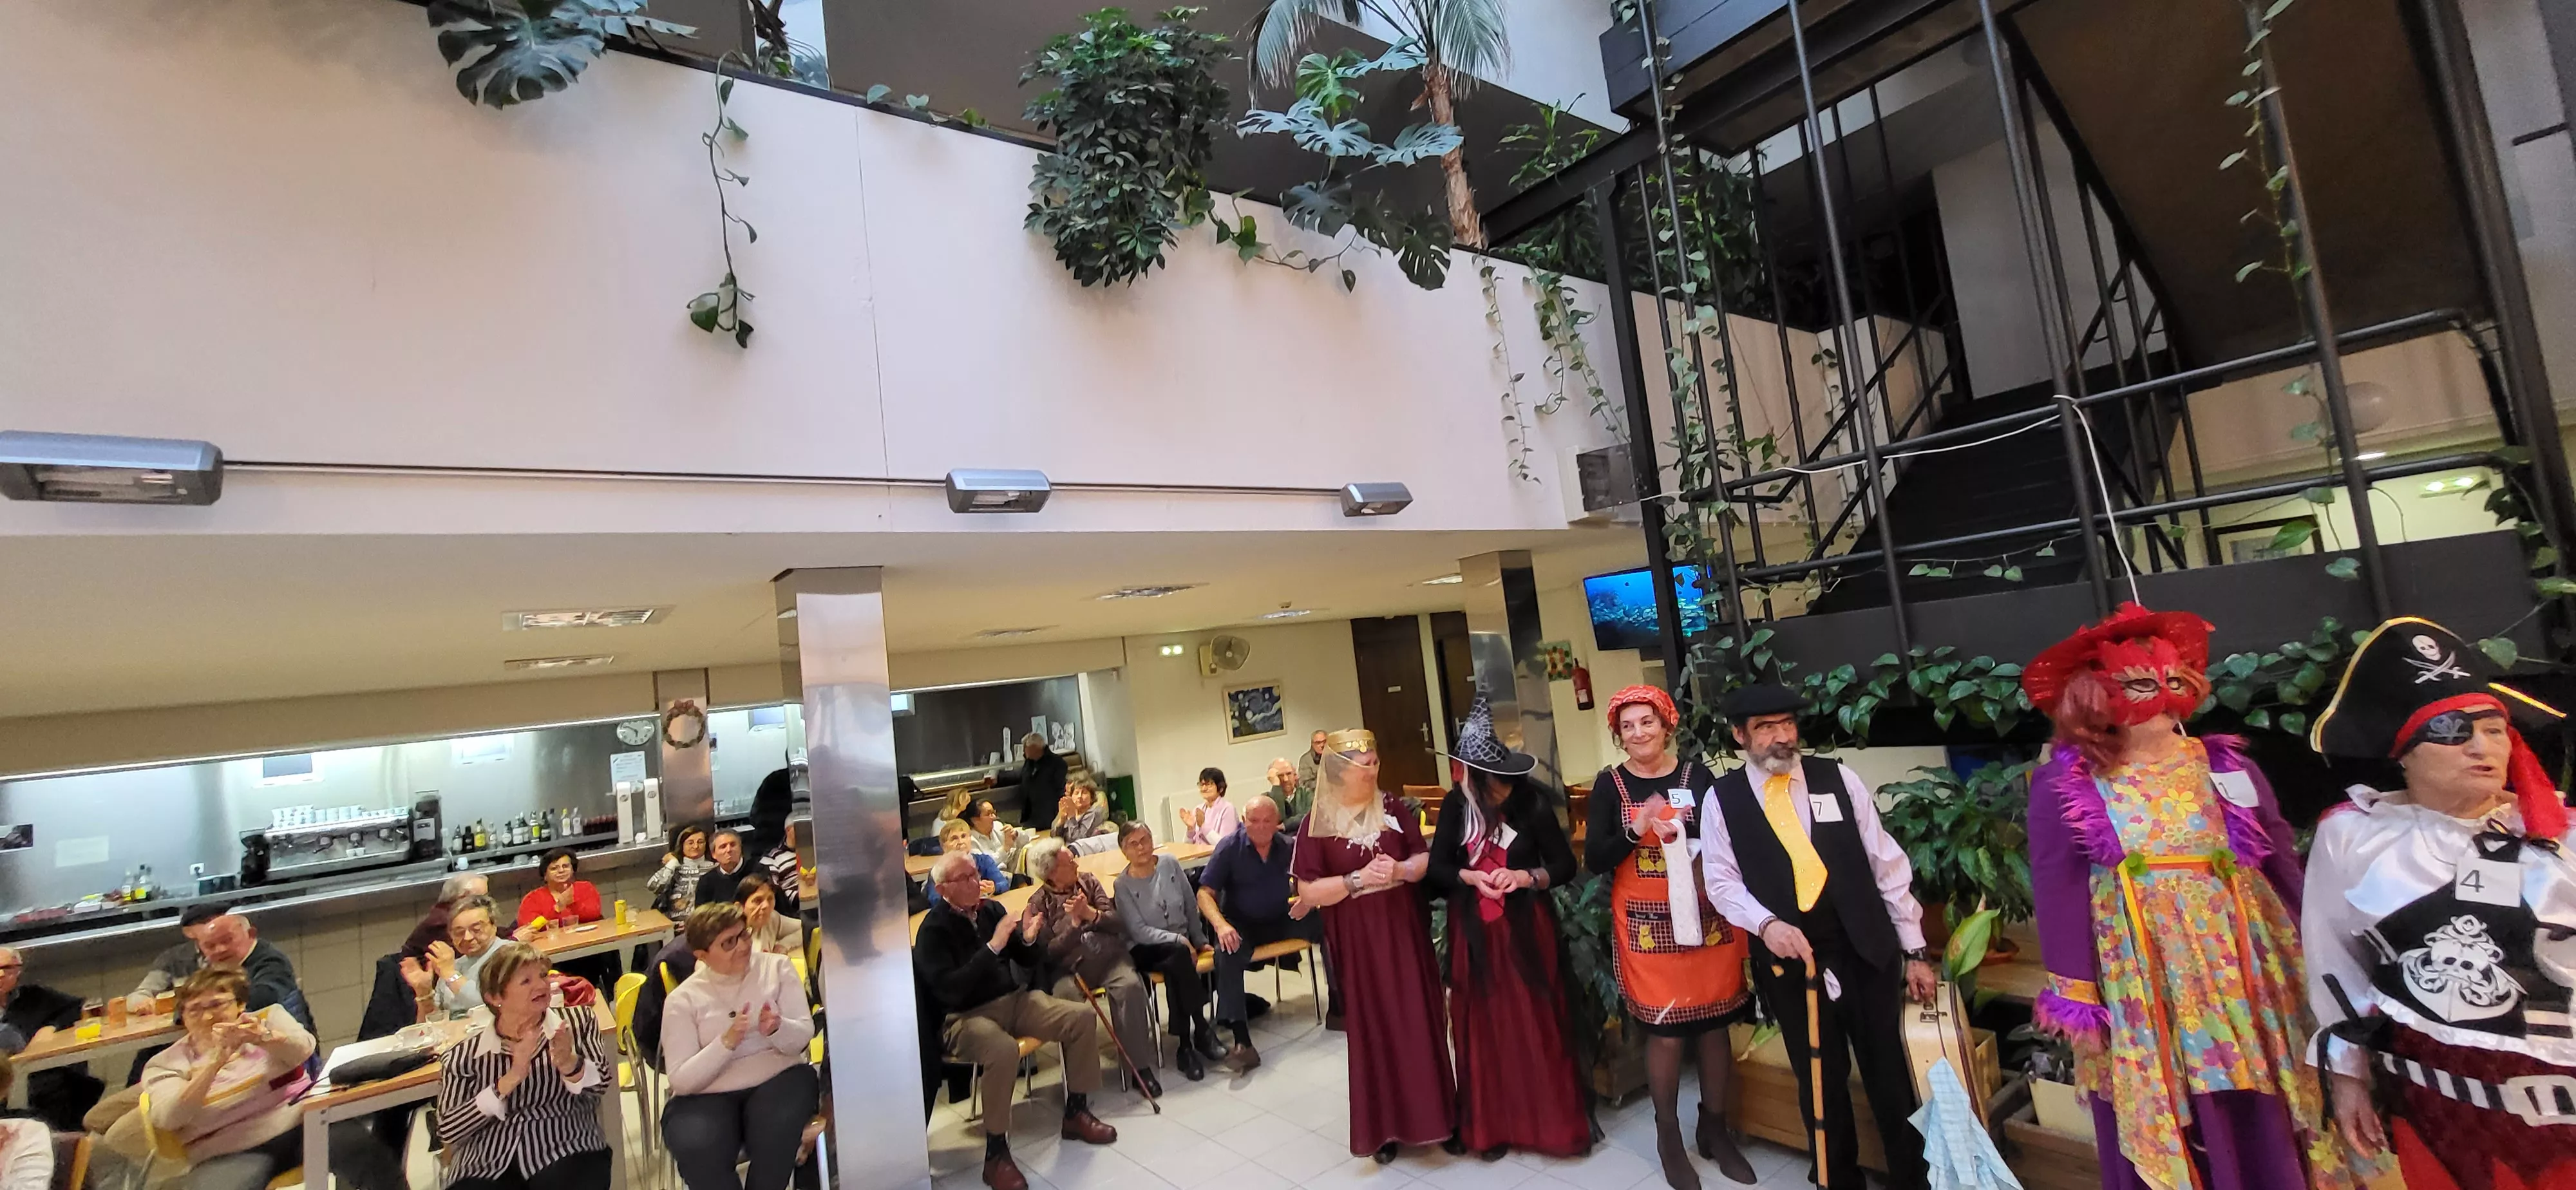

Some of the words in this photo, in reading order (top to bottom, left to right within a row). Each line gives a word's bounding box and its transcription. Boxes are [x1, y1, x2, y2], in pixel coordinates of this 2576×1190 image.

[1671, 793, 1681, 804] 5
[1813, 801, 1823, 816] 7
[2460, 869, 2485, 892] 4
